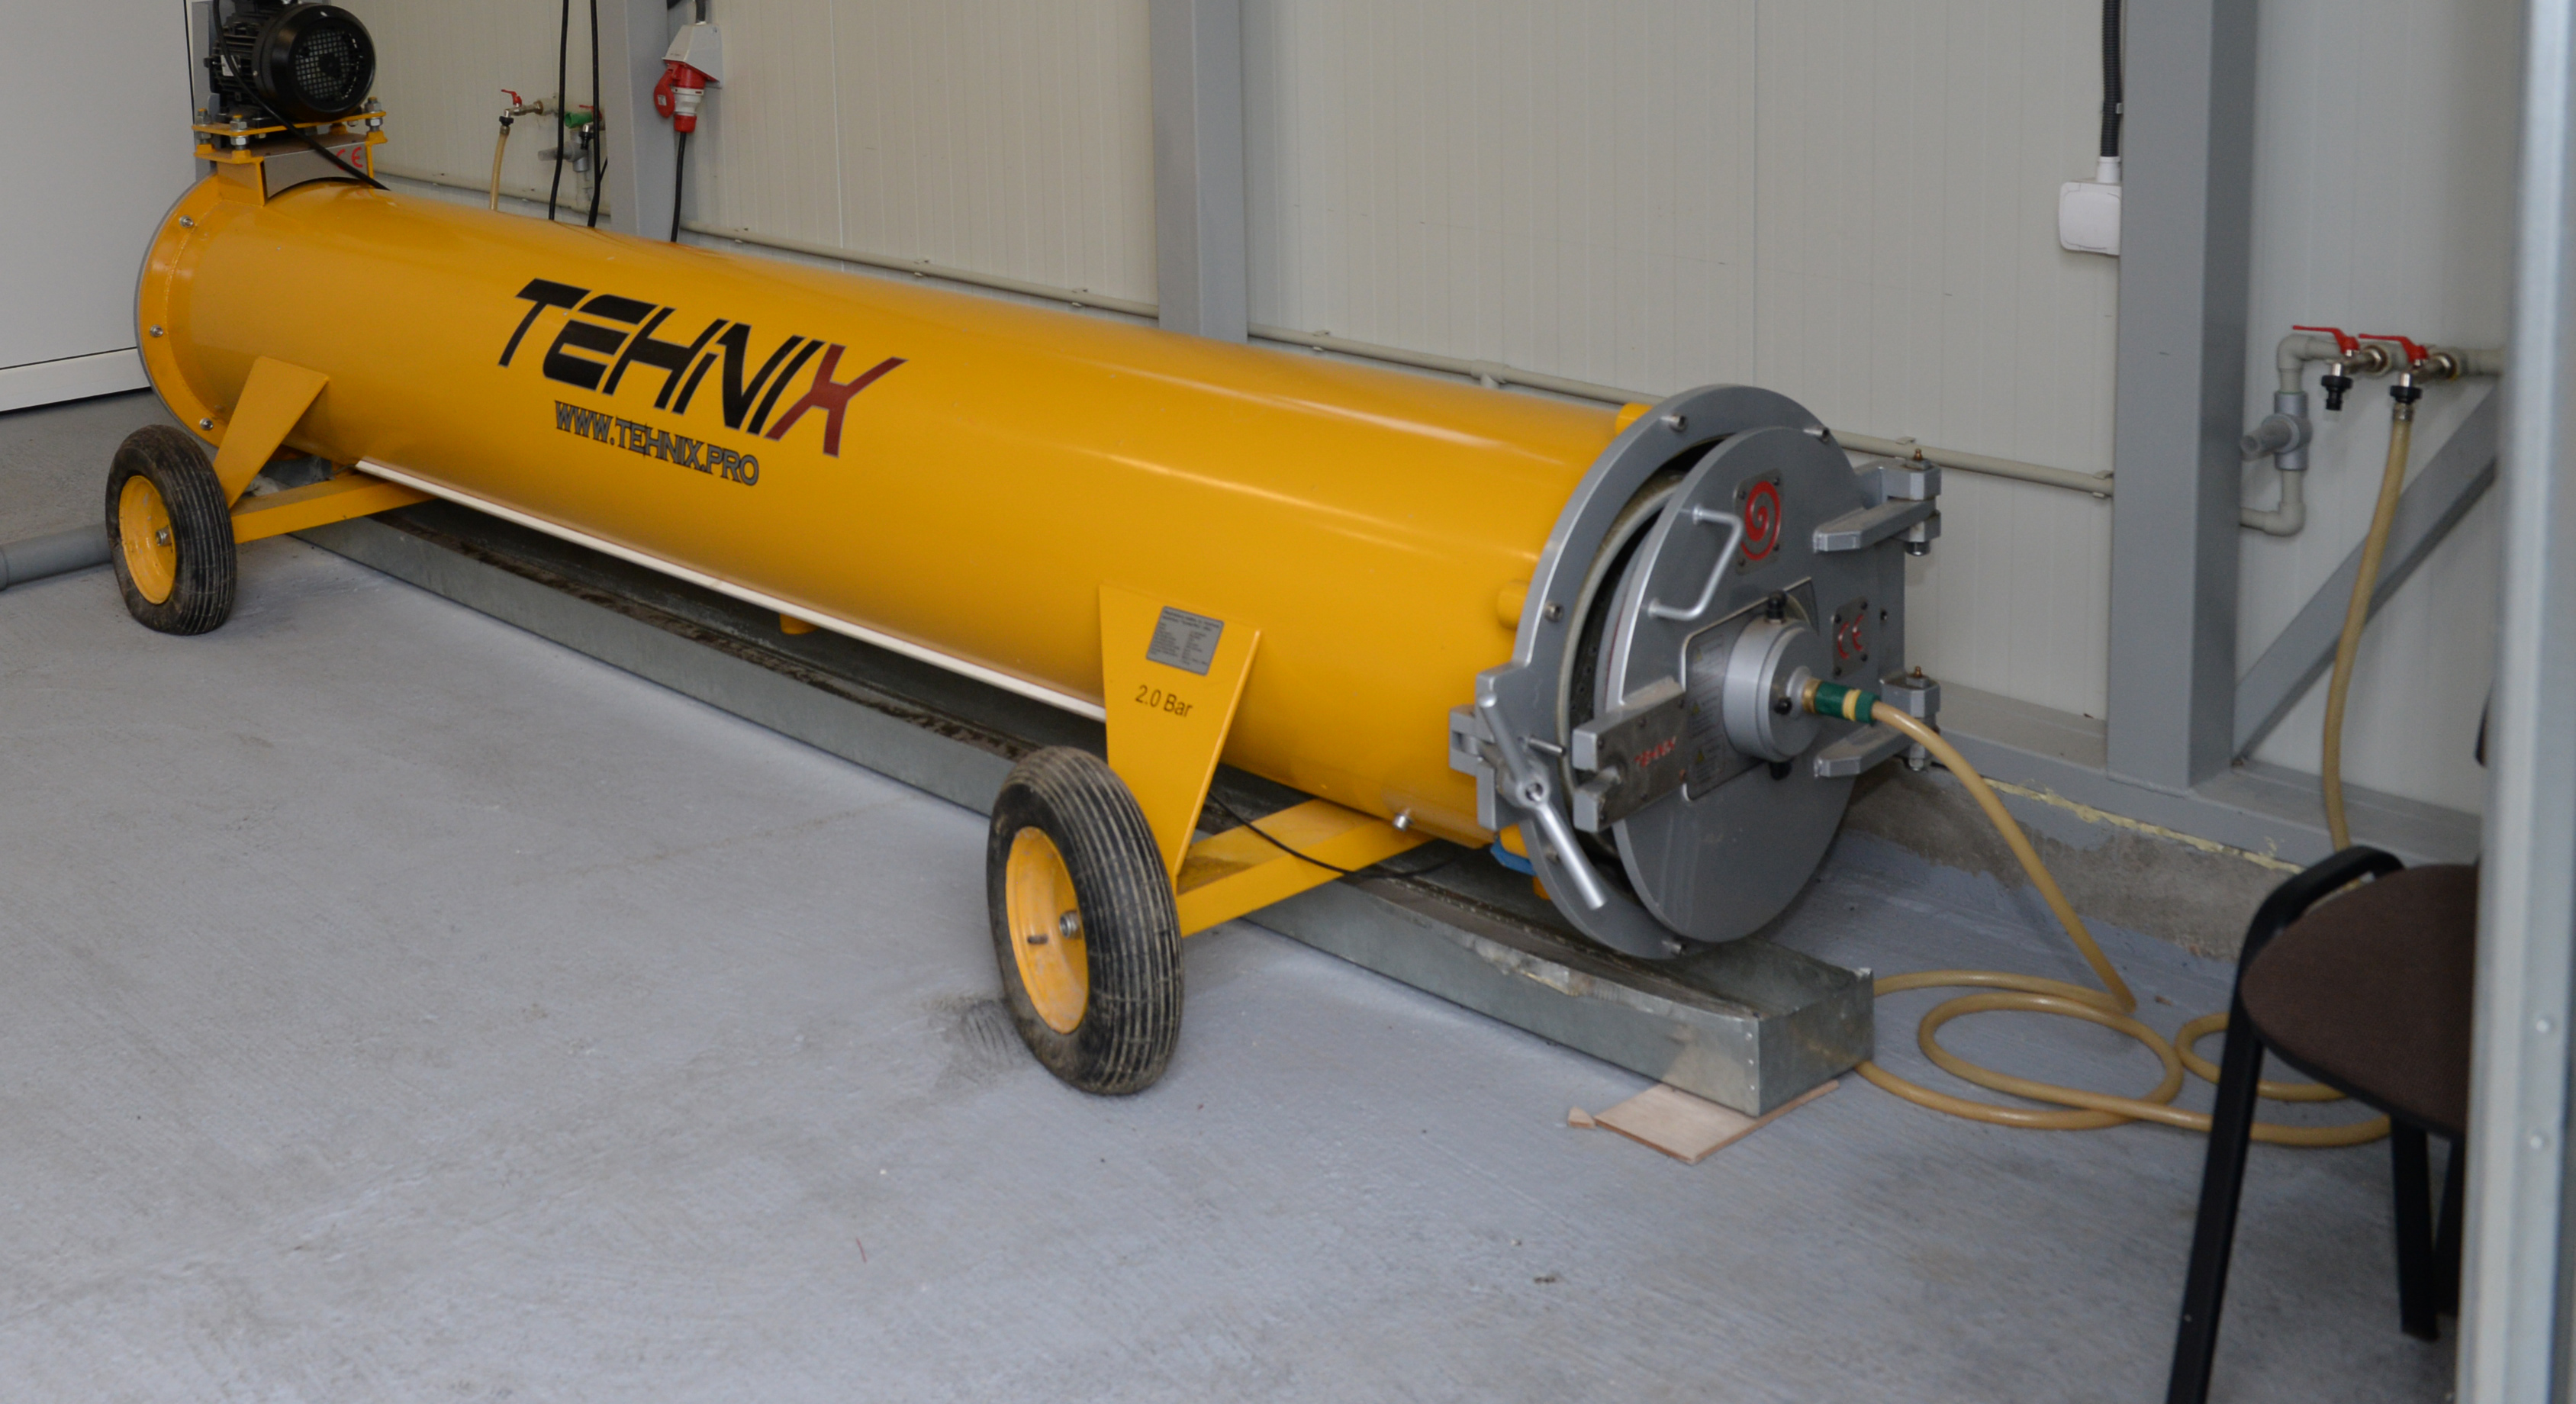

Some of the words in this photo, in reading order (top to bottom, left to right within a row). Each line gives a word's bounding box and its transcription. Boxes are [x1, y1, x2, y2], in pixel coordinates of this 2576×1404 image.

[497, 278, 909, 458] TEHNIX
[554, 399, 760, 487] WWW.TEHNIX.PRO
[1135, 684, 1161, 708] 2.0
[1164, 693, 1193, 718] Bar
